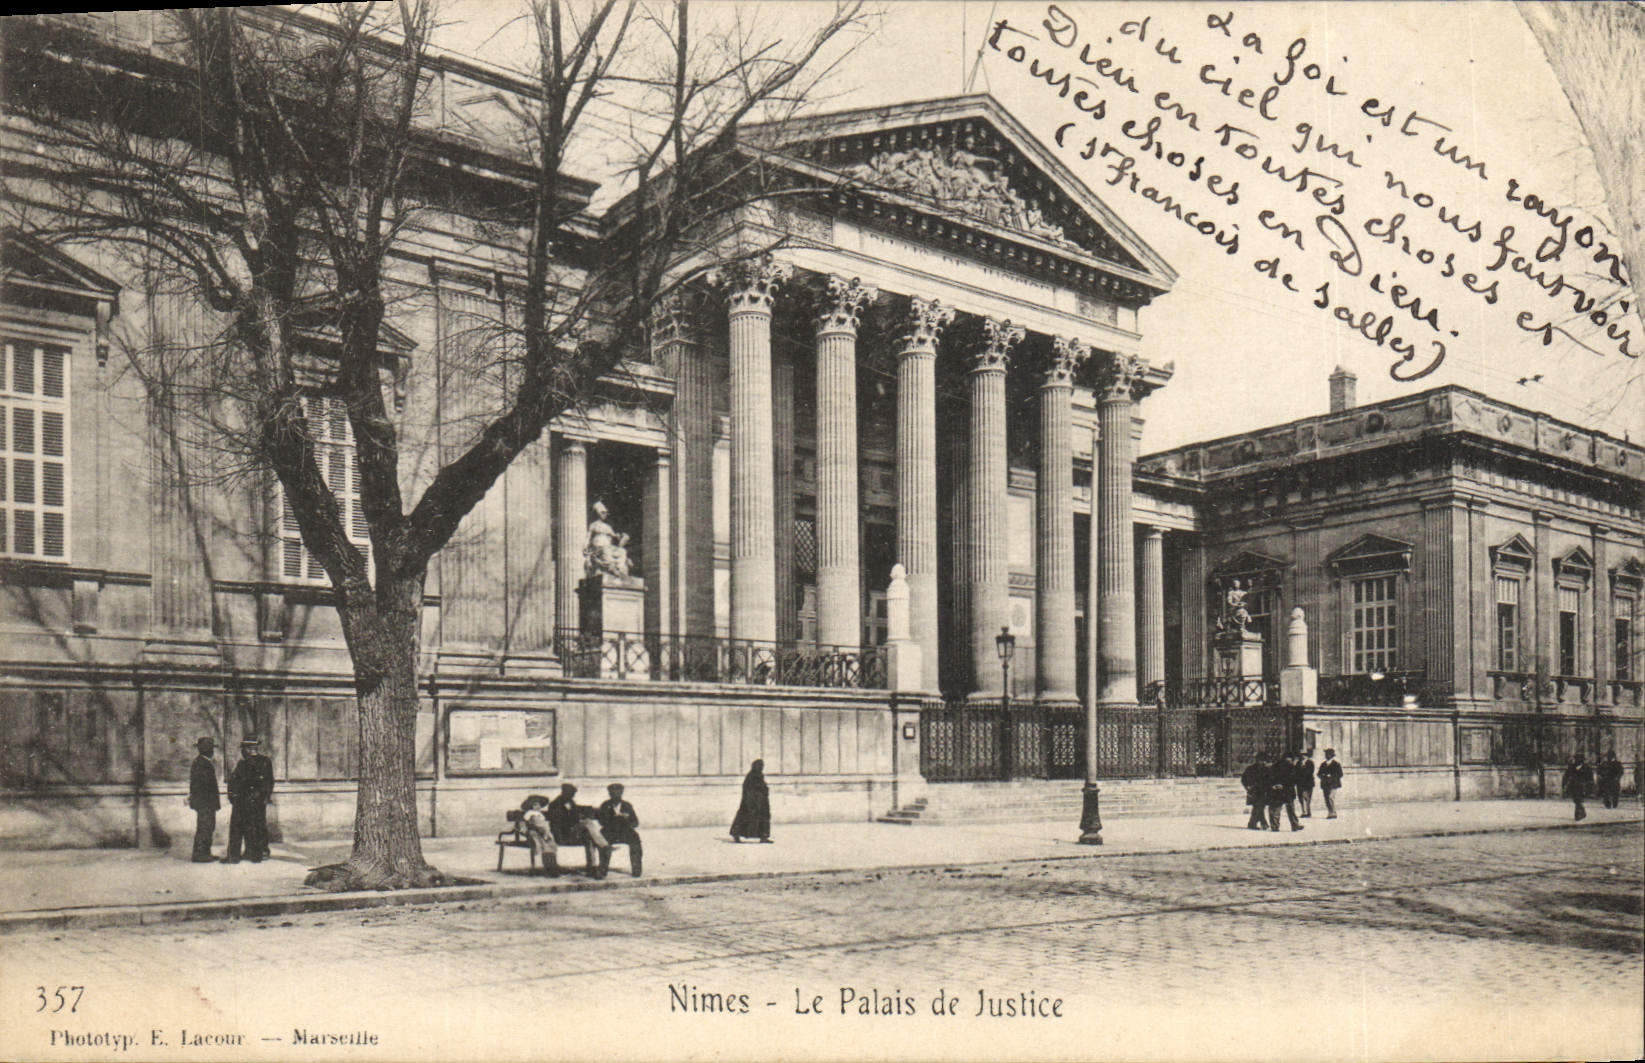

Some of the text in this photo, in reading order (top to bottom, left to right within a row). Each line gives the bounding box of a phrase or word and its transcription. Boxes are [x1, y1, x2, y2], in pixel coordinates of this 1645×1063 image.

[988, 19, 1106, 120] toutes
[1121, 116, 1239, 206] choses
[1258, 210, 1305, 250] en
[1043, 5, 1605, 357] Dieu en toutes choses et
[1120, 16, 1182, 64] du
[1200, 55, 1278, 121] ciel
[1292, 122, 1369, 168] qui
[1385, 171, 1481, 242] nous
[1275, 38, 1347, 95] foi
[1361, 98, 1452, 136] est
[1434, 137, 1488, 180] un
[1506, 178, 1628, 286] rayon
[1254, 257, 1300, 292] de
